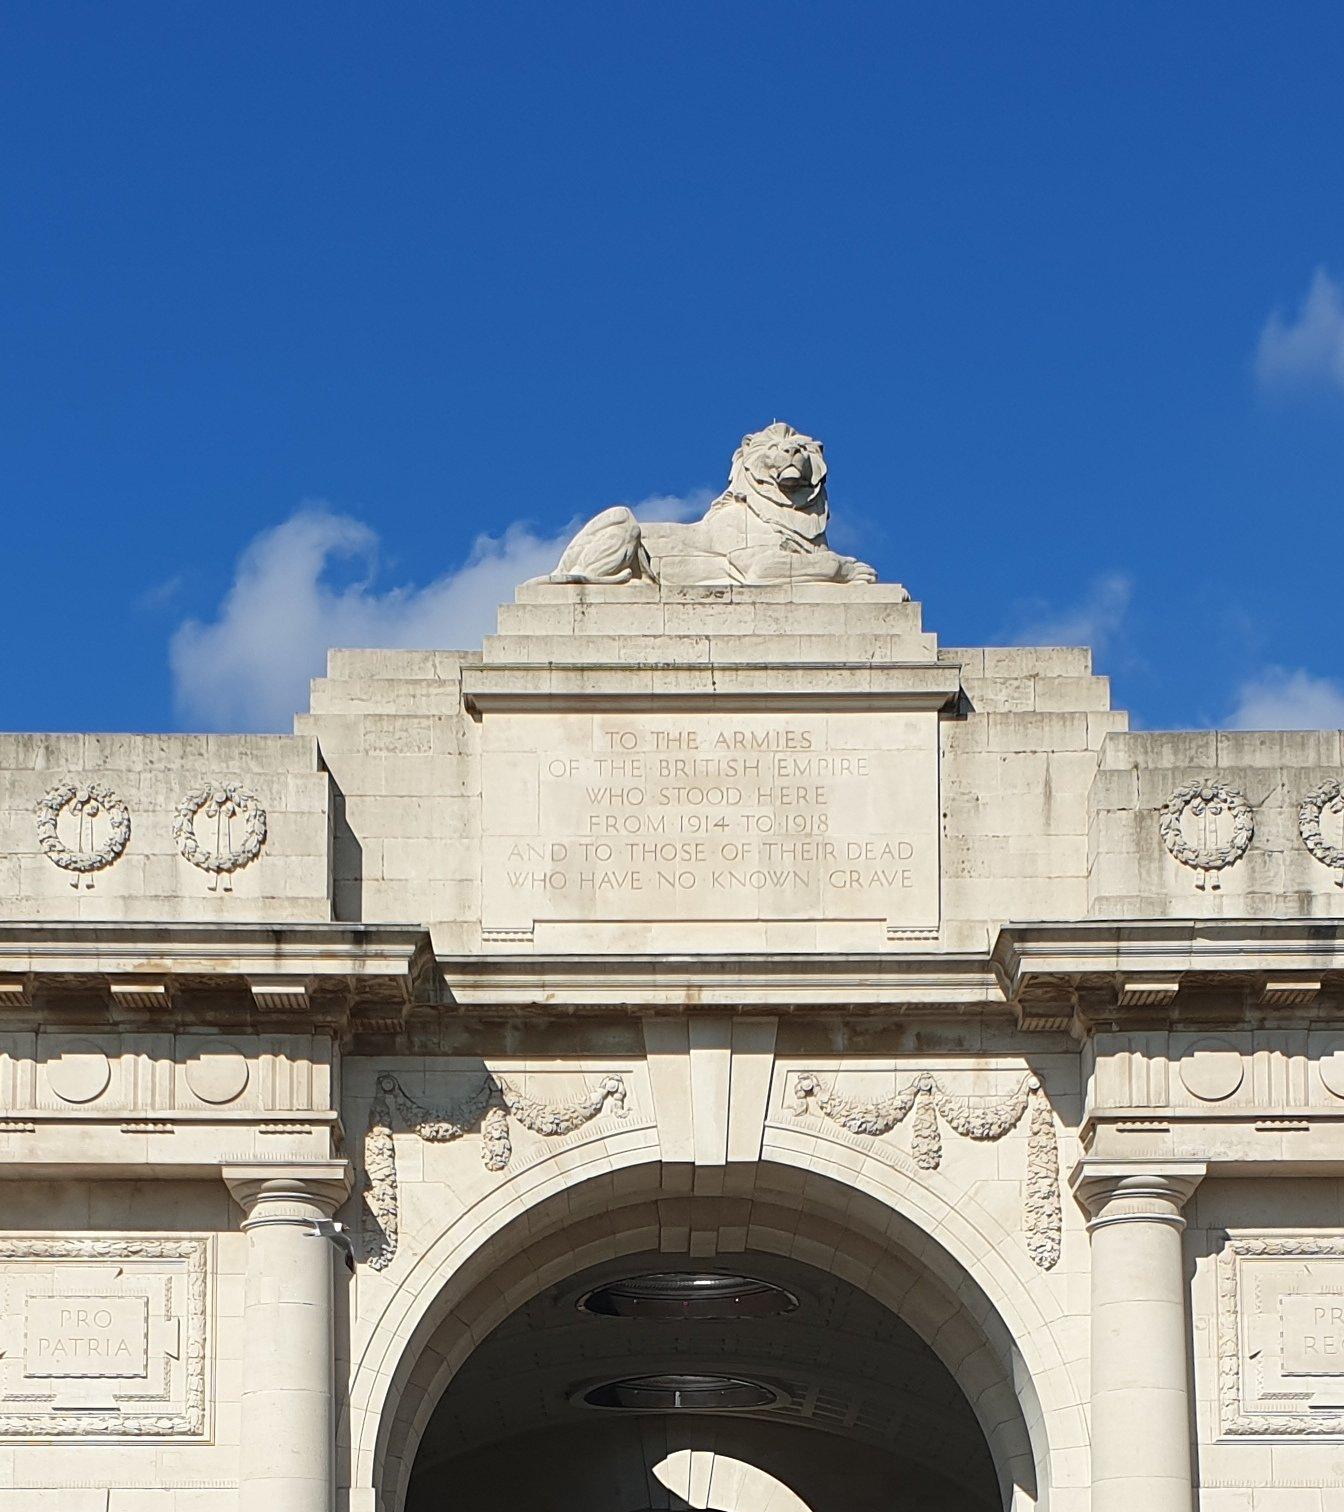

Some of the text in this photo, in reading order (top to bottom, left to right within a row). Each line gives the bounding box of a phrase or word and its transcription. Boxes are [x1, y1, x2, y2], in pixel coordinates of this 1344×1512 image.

[605, 730, 812, 750] TO THE ARMIES
[548, 757, 870, 778] OF THE BRITISH EMPIRE
[586, 786, 828, 806] WHO STOOD HERE
[589, 813, 830, 835] FROM 1914 TO 1918
[507, 841, 914, 862] AND TO THOSE OF THEIR DEAD
[507, 869, 914, 890] WHO HAVE NO KNOWN GRAVE
[60, 1309, 112, 1328] PRO
[38, 1338, 132, 1357] PATRIA
